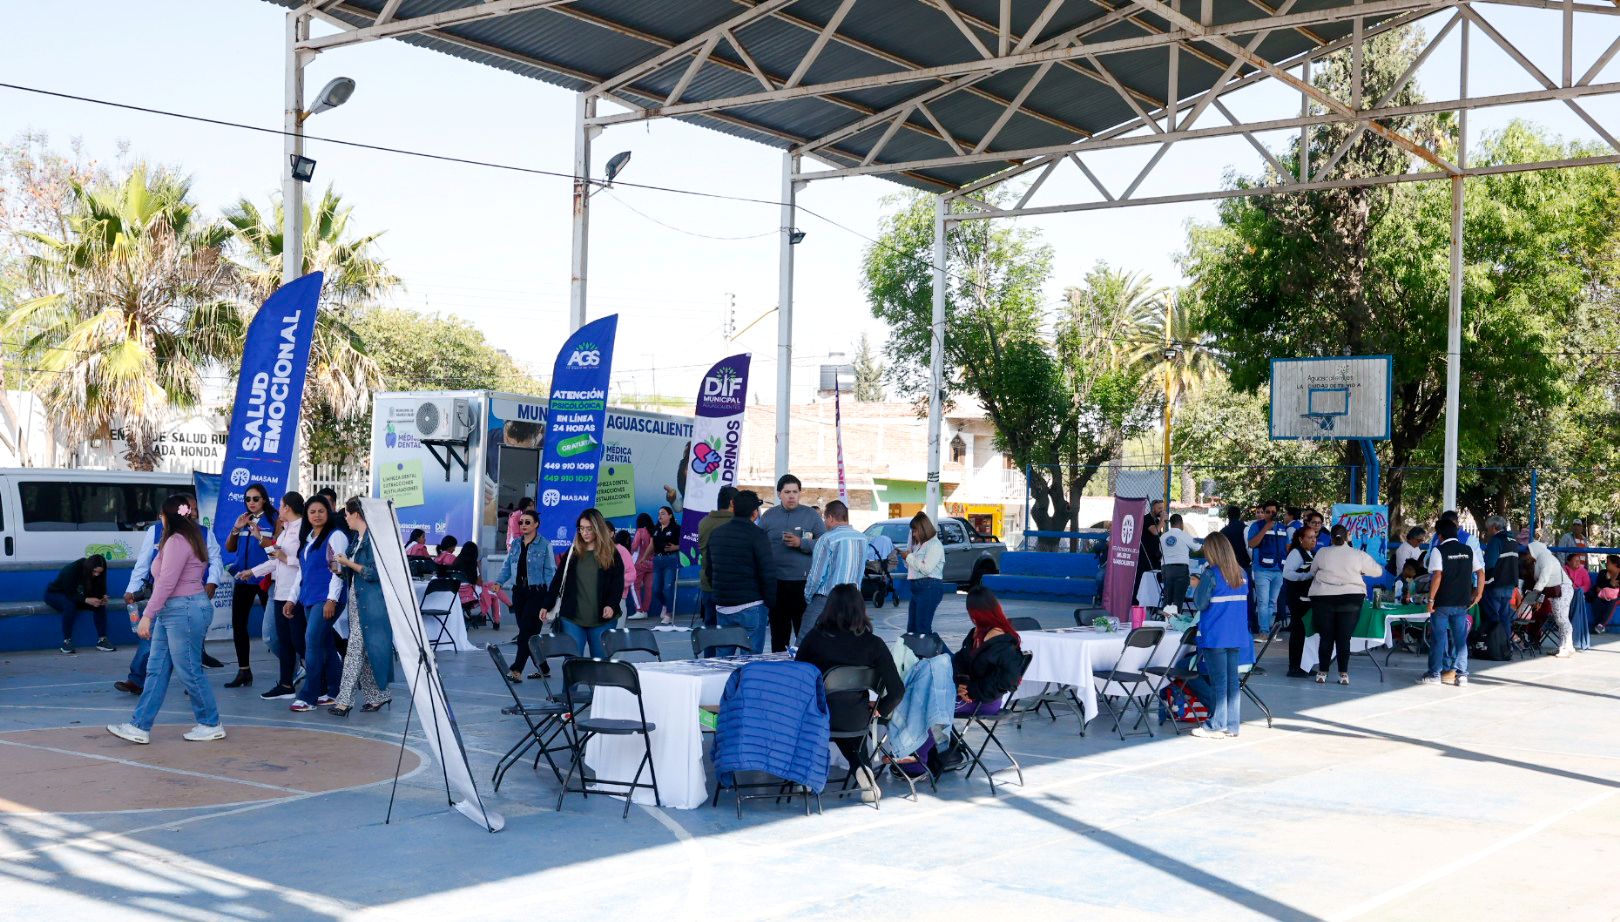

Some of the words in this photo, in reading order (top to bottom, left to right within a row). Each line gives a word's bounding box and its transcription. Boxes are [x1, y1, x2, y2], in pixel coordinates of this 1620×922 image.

[567, 350, 600, 366] AGS
[262, 309, 301, 454] EMOCIONAL
[704, 375, 743, 397] DIF
[553, 388, 604, 399] ATENCIÓN
[703, 395, 740, 404] MUNICIPAL
[552, 401, 601, 409] PSICOLÓGICA
[242, 372, 269, 452] SALUD
[556, 414, 568, 422] EN
[570, 413, 594, 422] LÍNEA
[518, 404, 548, 421] MUN
[606, 415, 694, 438] AGUASCALIENTE
[552, 424, 565, 432] 24
[566, 424, 595, 432] HORAS
[172, 432, 207, 444] SALUD
[211, 434, 228, 445] RU
[154, 444, 176, 457] ADA
[180, 445, 218, 457] HONDA
[606, 443, 632, 456] MÉDICA
[721, 420, 740, 487] DRINOS
[606, 454, 632, 464] DENTAL
[544, 462, 561, 470] 449
[576, 462, 595, 470] 1099
[251, 475, 279, 484] IMASAM
[561, 494, 590, 502] IMASAM
